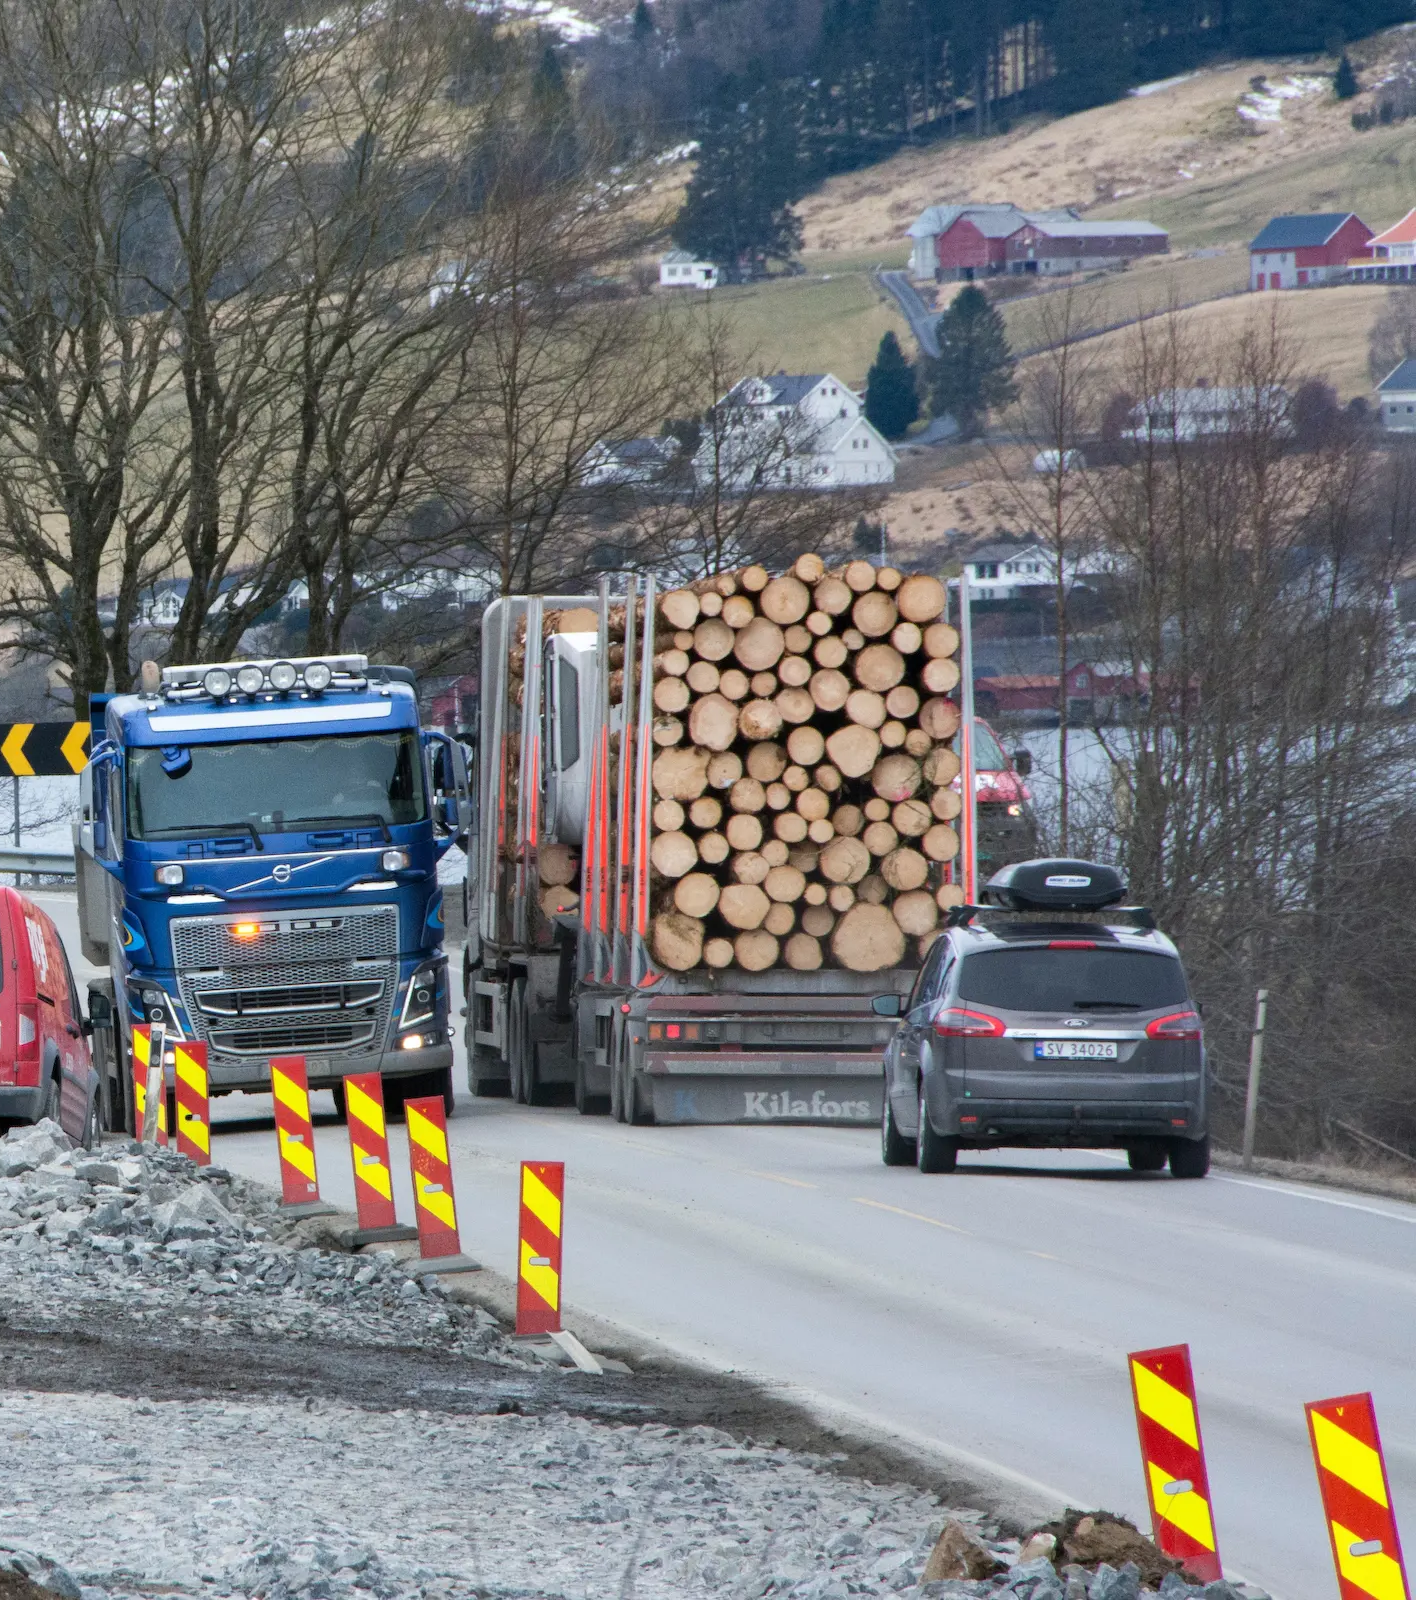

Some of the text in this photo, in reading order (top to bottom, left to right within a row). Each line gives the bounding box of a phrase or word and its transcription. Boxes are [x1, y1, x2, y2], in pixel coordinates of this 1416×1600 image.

[1047, 1043, 1114, 1056] SV 34026
[743, 1090, 871, 1119] Kilafors
